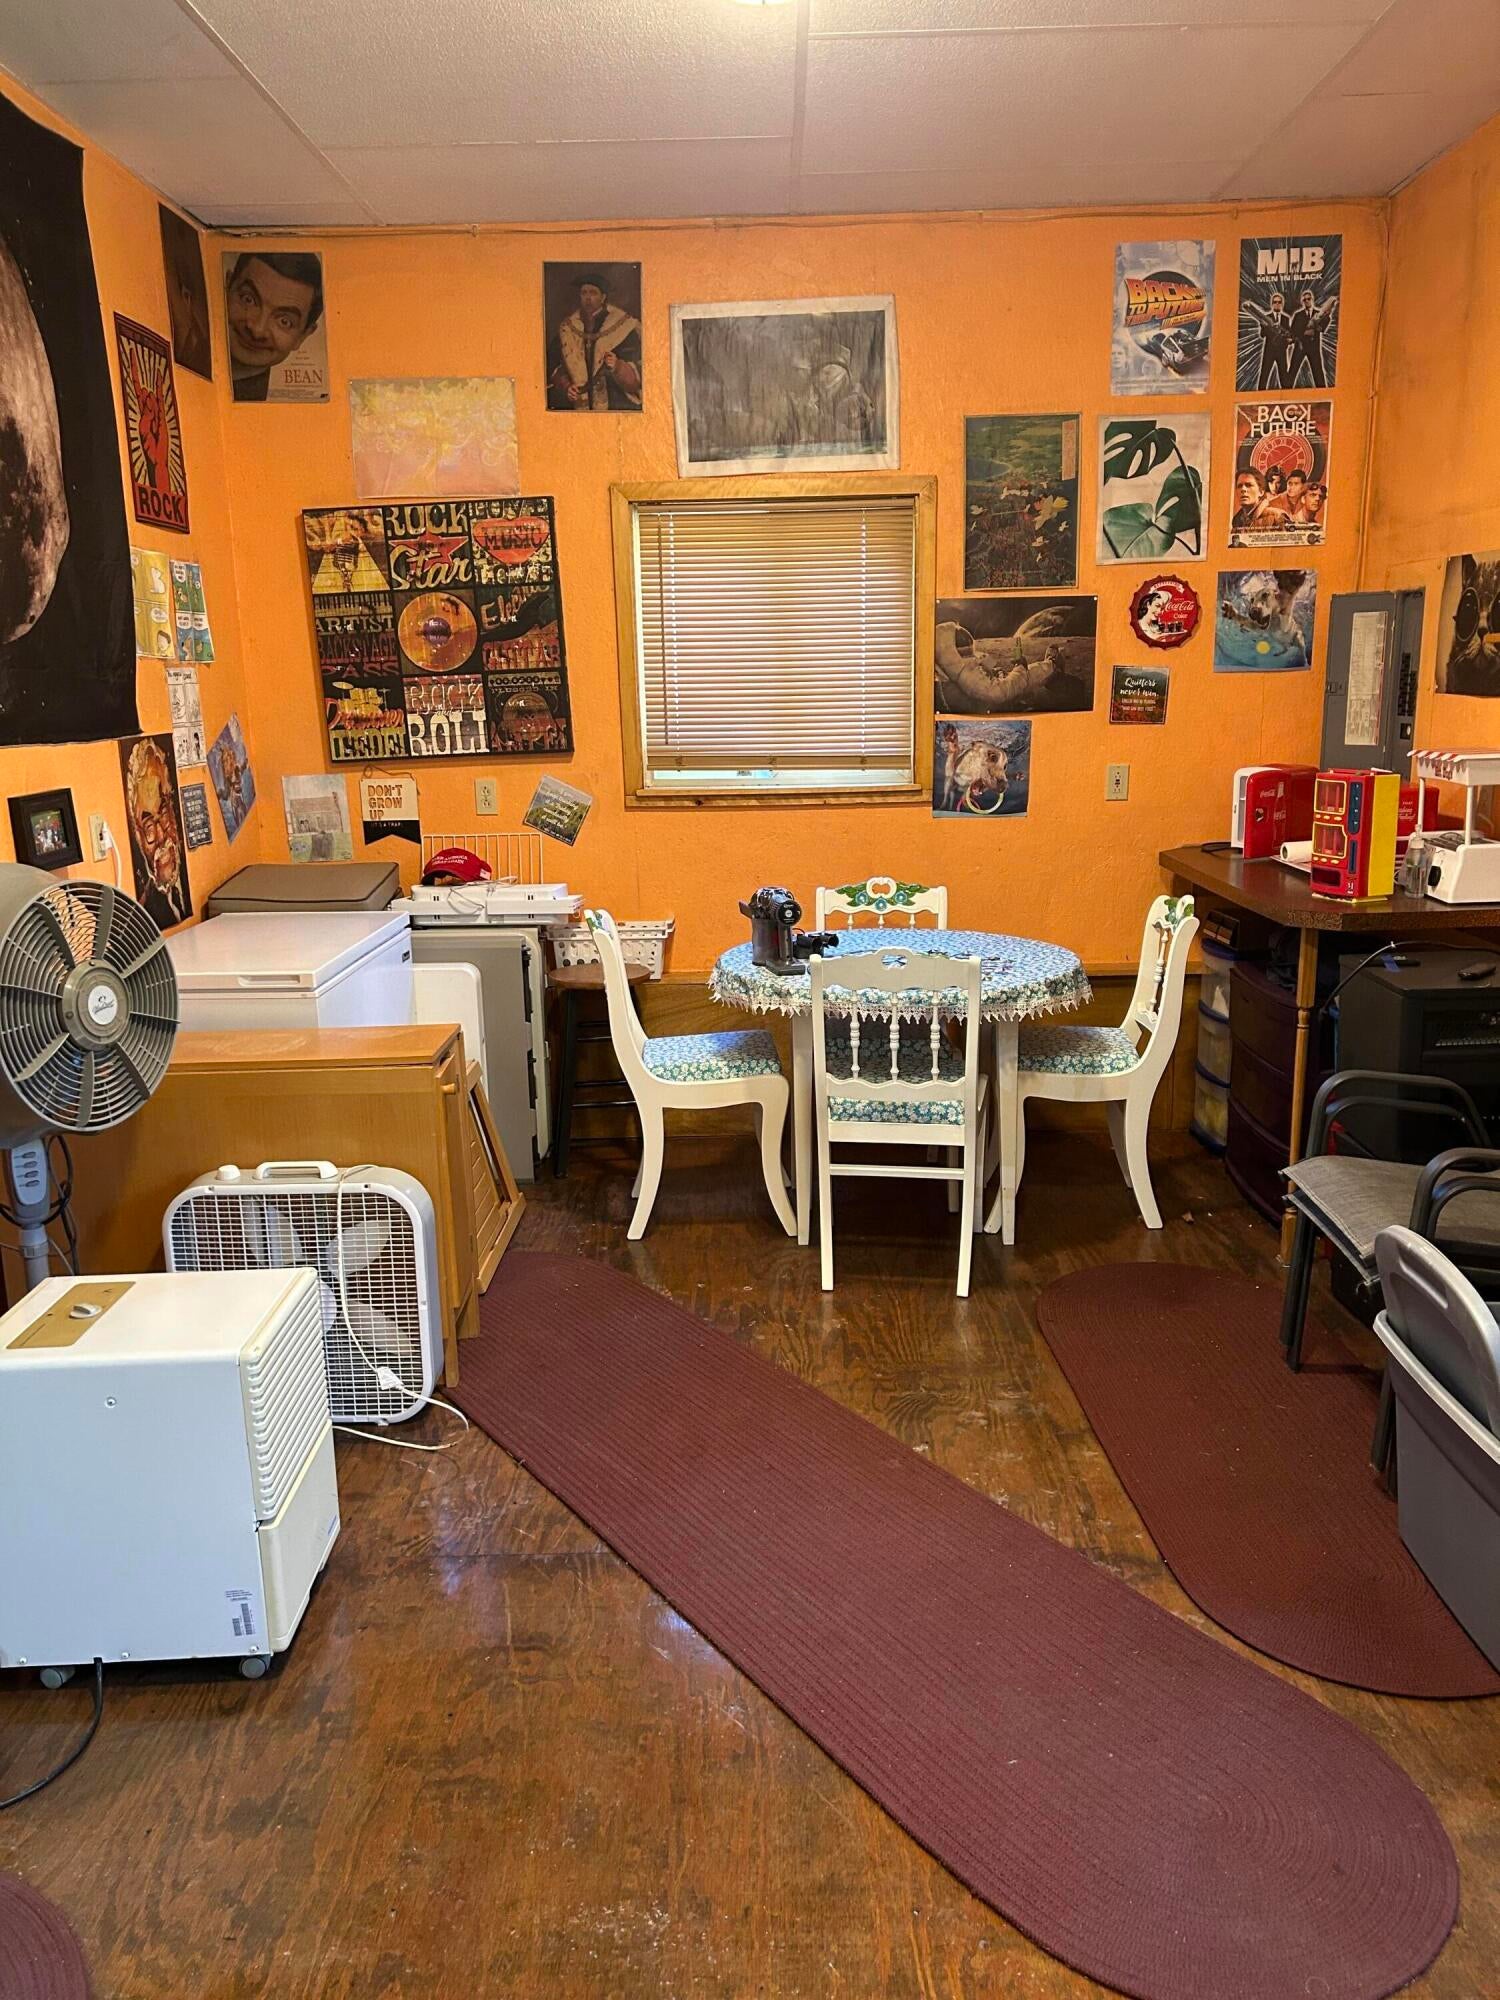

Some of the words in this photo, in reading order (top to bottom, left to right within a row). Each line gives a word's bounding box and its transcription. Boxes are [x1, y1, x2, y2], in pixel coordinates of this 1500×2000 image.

[1257, 246, 1325, 275] MIB
[1257, 275, 1278, 283] MEN
[1294, 273, 1323, 281] BLACK
[284, 369, 323, 384] BEAN
[1257, 404, 1312, 423] BACK
[1250, 421, 1316, 438] FUTURE
[138, 487, 185, 524] ROCK
[386, 503, 469, 537] ROCK
[482, 525, 542, 551] MUSIC
[389, 544, 473, 590] Star
[315, 615, 395, 635] ARTIST
[1124, 677, 1156, 688] Quitters
[1120, 688, 1141, 696] never
[407, 709, 490, 757] ROLL
[368, 784, 403, 797] DON'T
[368, 797, 403, 809] GROW
[369, 809, 385, 820] UP
